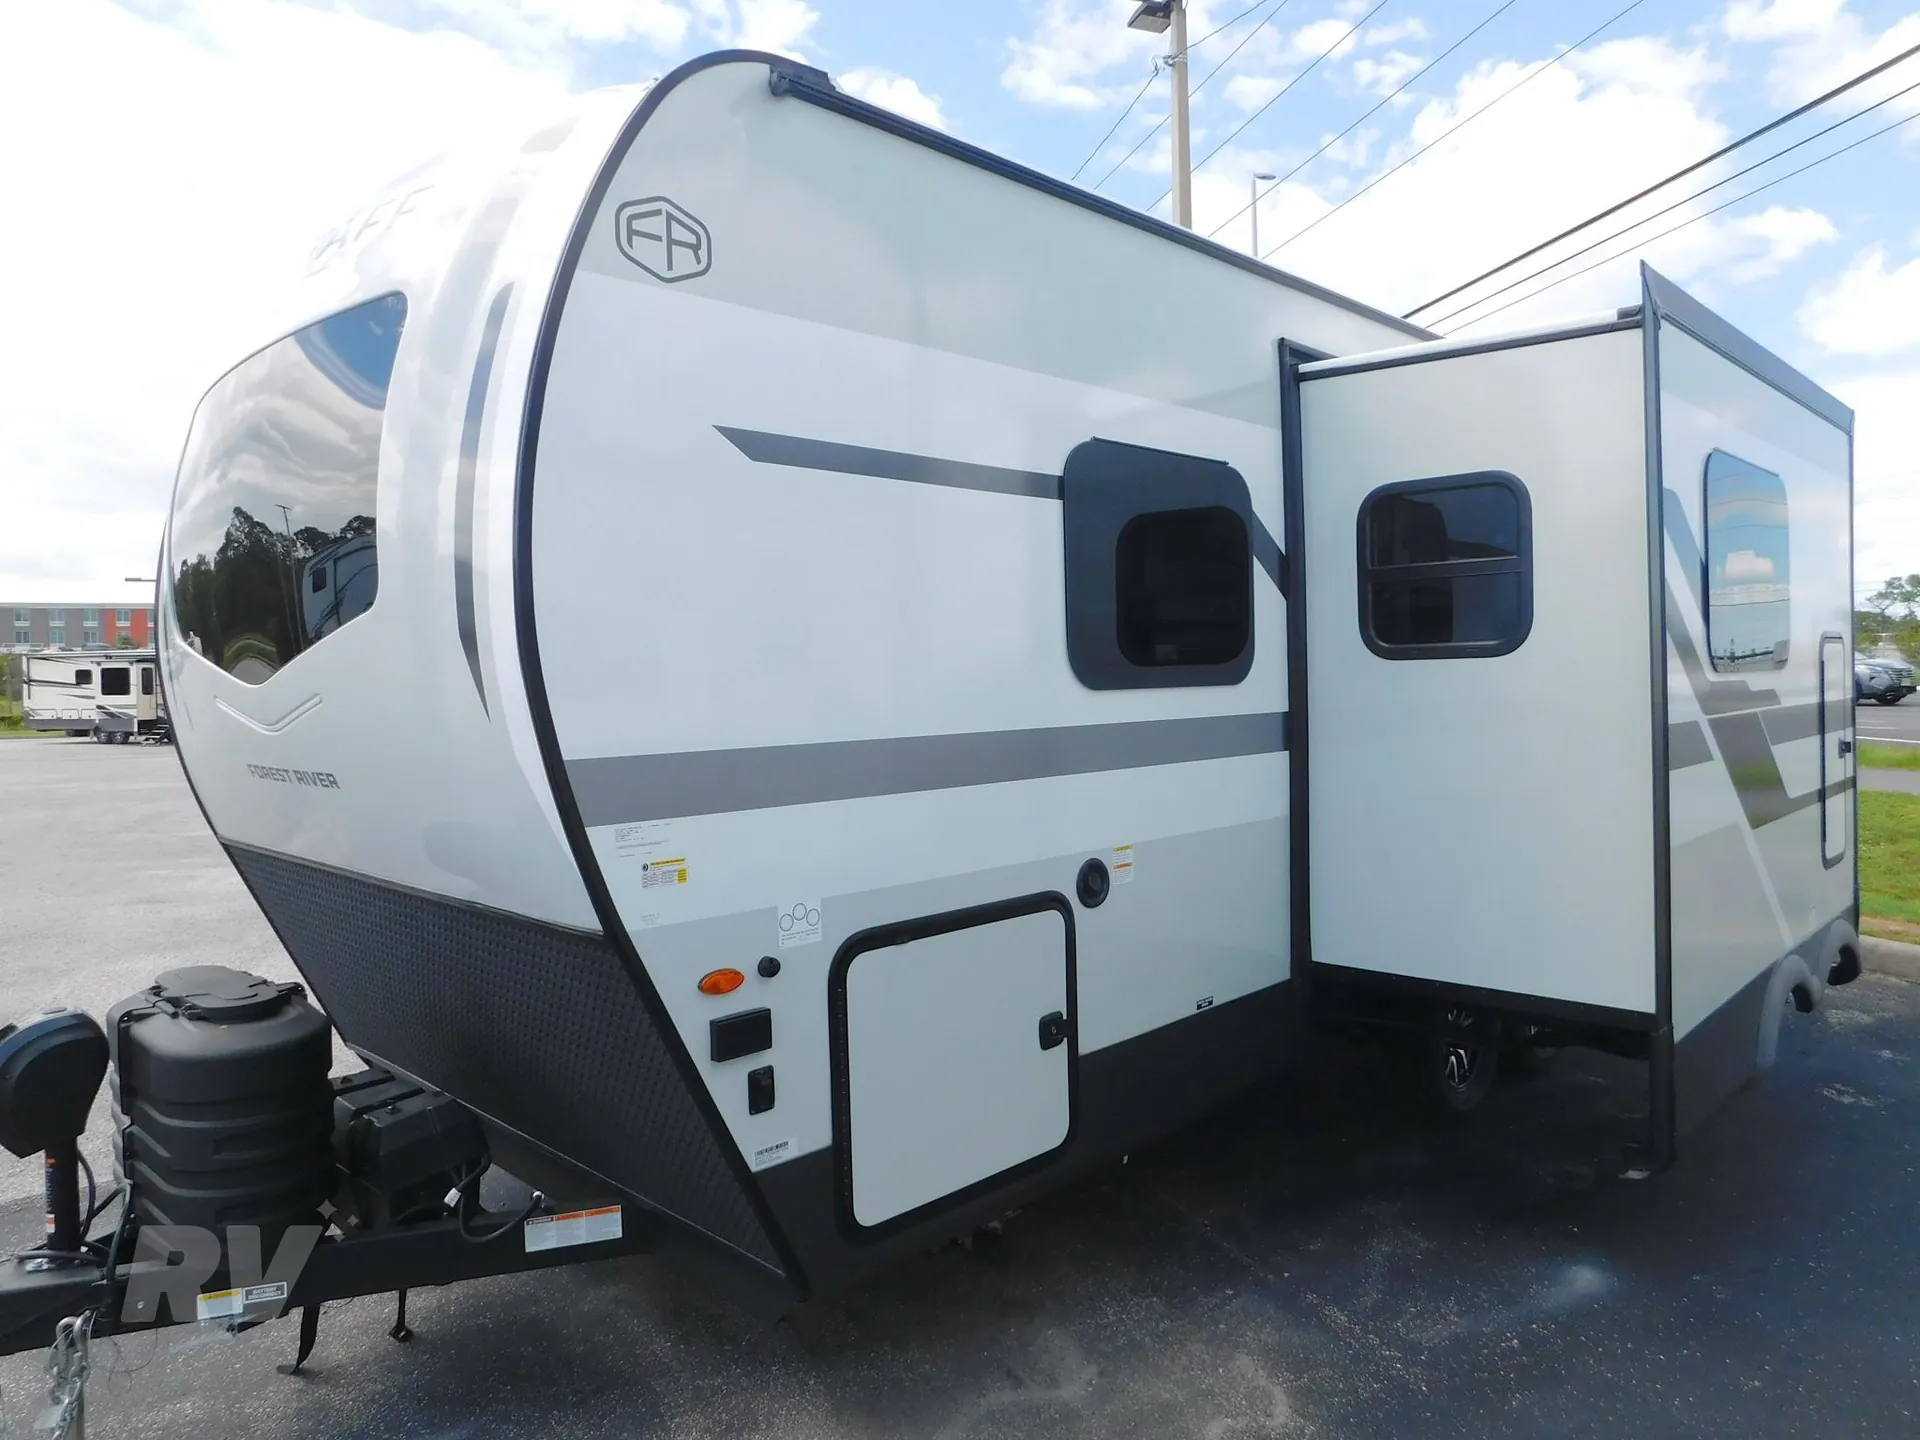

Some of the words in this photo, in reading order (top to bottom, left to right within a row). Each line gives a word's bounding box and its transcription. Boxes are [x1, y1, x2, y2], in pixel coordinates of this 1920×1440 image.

[626, 208, 703, 272] FR
[246, 763, 293, 784] FOREST
[292, 769, 341, 790] RIVER
